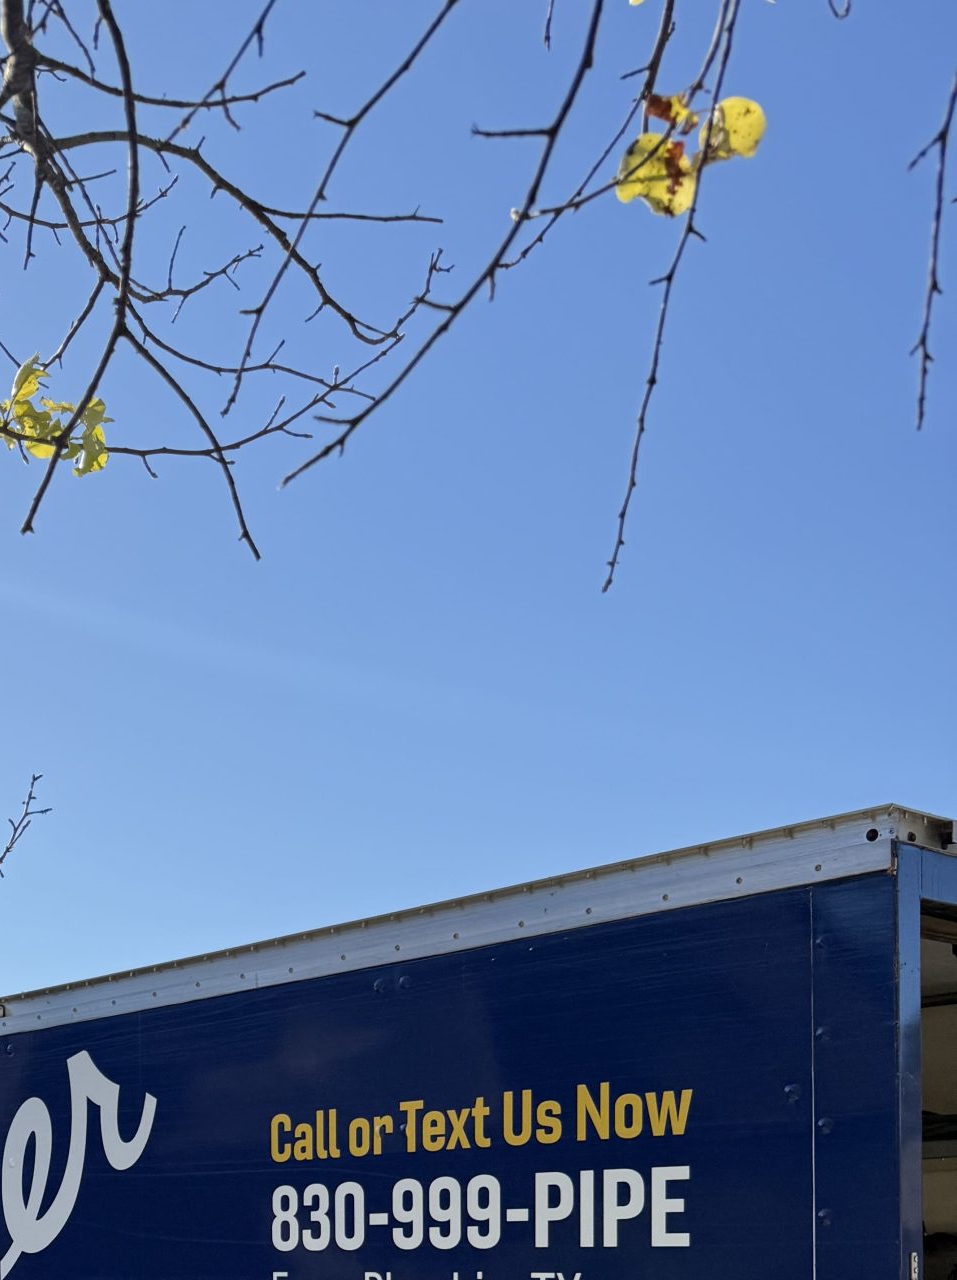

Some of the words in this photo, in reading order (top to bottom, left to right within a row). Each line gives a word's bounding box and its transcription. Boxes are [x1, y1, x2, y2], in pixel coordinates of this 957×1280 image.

[270, 1108, 341, 1163] Call
[348, 1113, 394, 1157] or
[399, 1096, 491, 1154] Text
[502, 1088, 563, 1147] Us
[576, 1081, 694, 1143] Now
[271, 1165, 691, 1253] 830-999-PIPE
